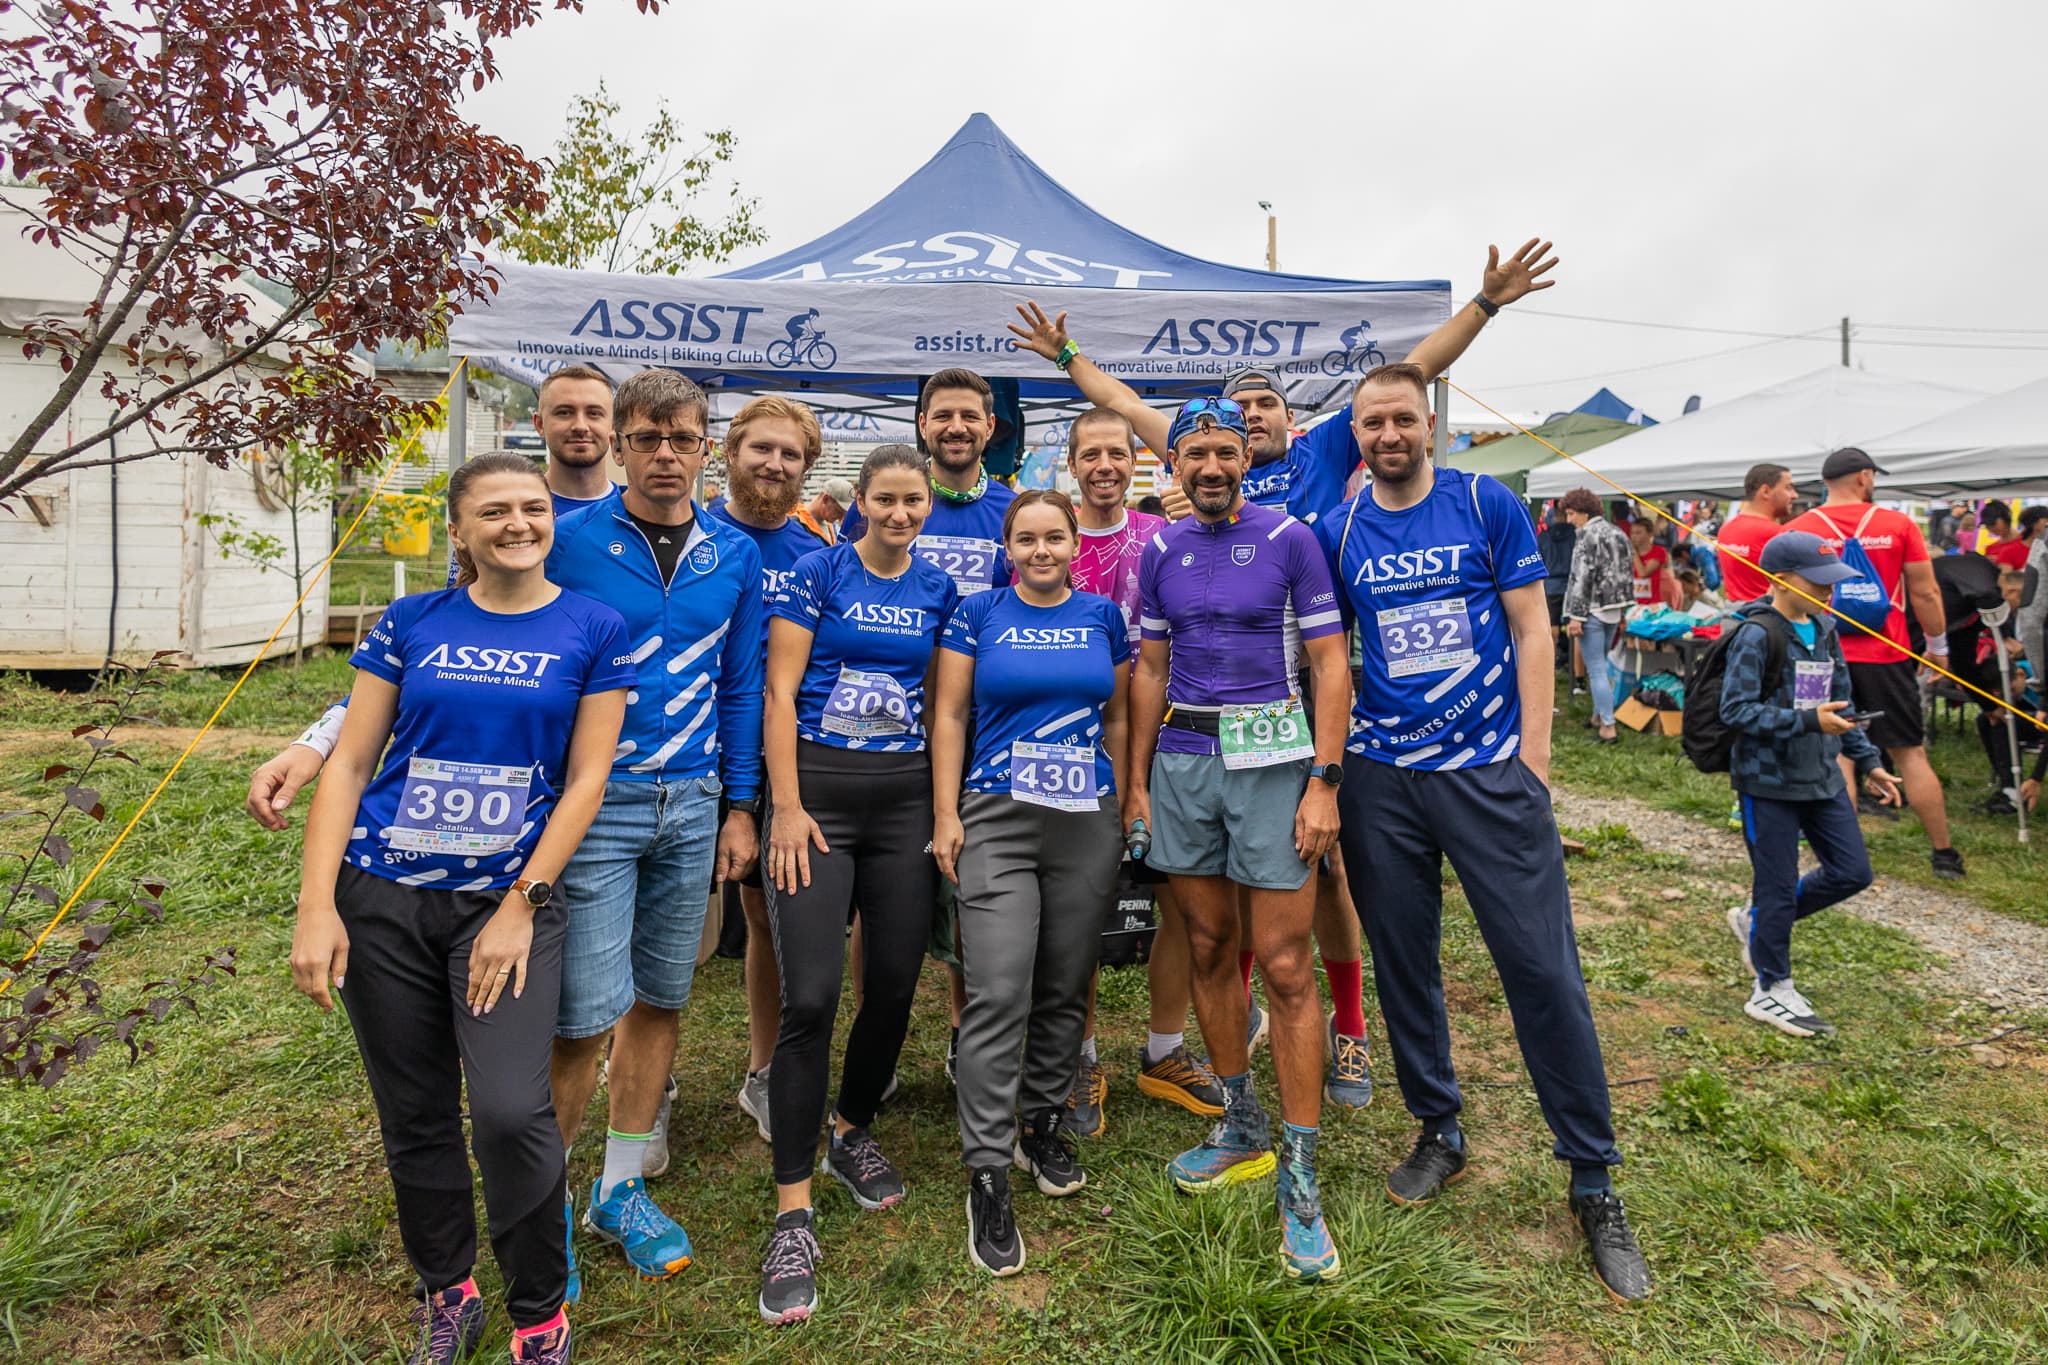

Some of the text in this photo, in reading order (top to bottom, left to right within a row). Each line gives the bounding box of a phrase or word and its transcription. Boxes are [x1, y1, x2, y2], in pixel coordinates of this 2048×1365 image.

[570, 299, 764, 344] ASSIST
[914, 330, 1019, 353] assist.ro
[1142, 318, 1320, 356] ASSIST
[517, 339, 604, 357] Innovative
[607, 343, 659, 360] Minds
[671, 347, 723, 366] Biking
[727, 349, 763, 364] Club
[1177, 360, 1222, 374] Minds
[1285, 360, 1318, 374] Club
[1354, 543, 1470, 585] ASSIST
[790, 584, 811, 600] CLUB
[1371, 573, 1460, 595] Innovative Minds
[842, 602, 927, 628] ASSIST
[372, 629, 393, 646] CLUB
[858, 623, 922, 637] Innovative Minds
[995, 627, 1094, 643] ASSIST
[1387, 619, 1462, 654] 332
[1011, 642, 1089, 650] Innovative Minds
[418, 643, 560, 677] ASSIST
[437, 670, 540, 688] Innovative Minds
[834, 688, 906, 721] 309
[1390, 690, 1479, 744] SPORTS CLUB
[1228, 718, 1298, 745] 199
[1016, 762, 1086, 793] 430
[407, 785, 511, 826] 390
[435, 823, 474, 833] Catalina
